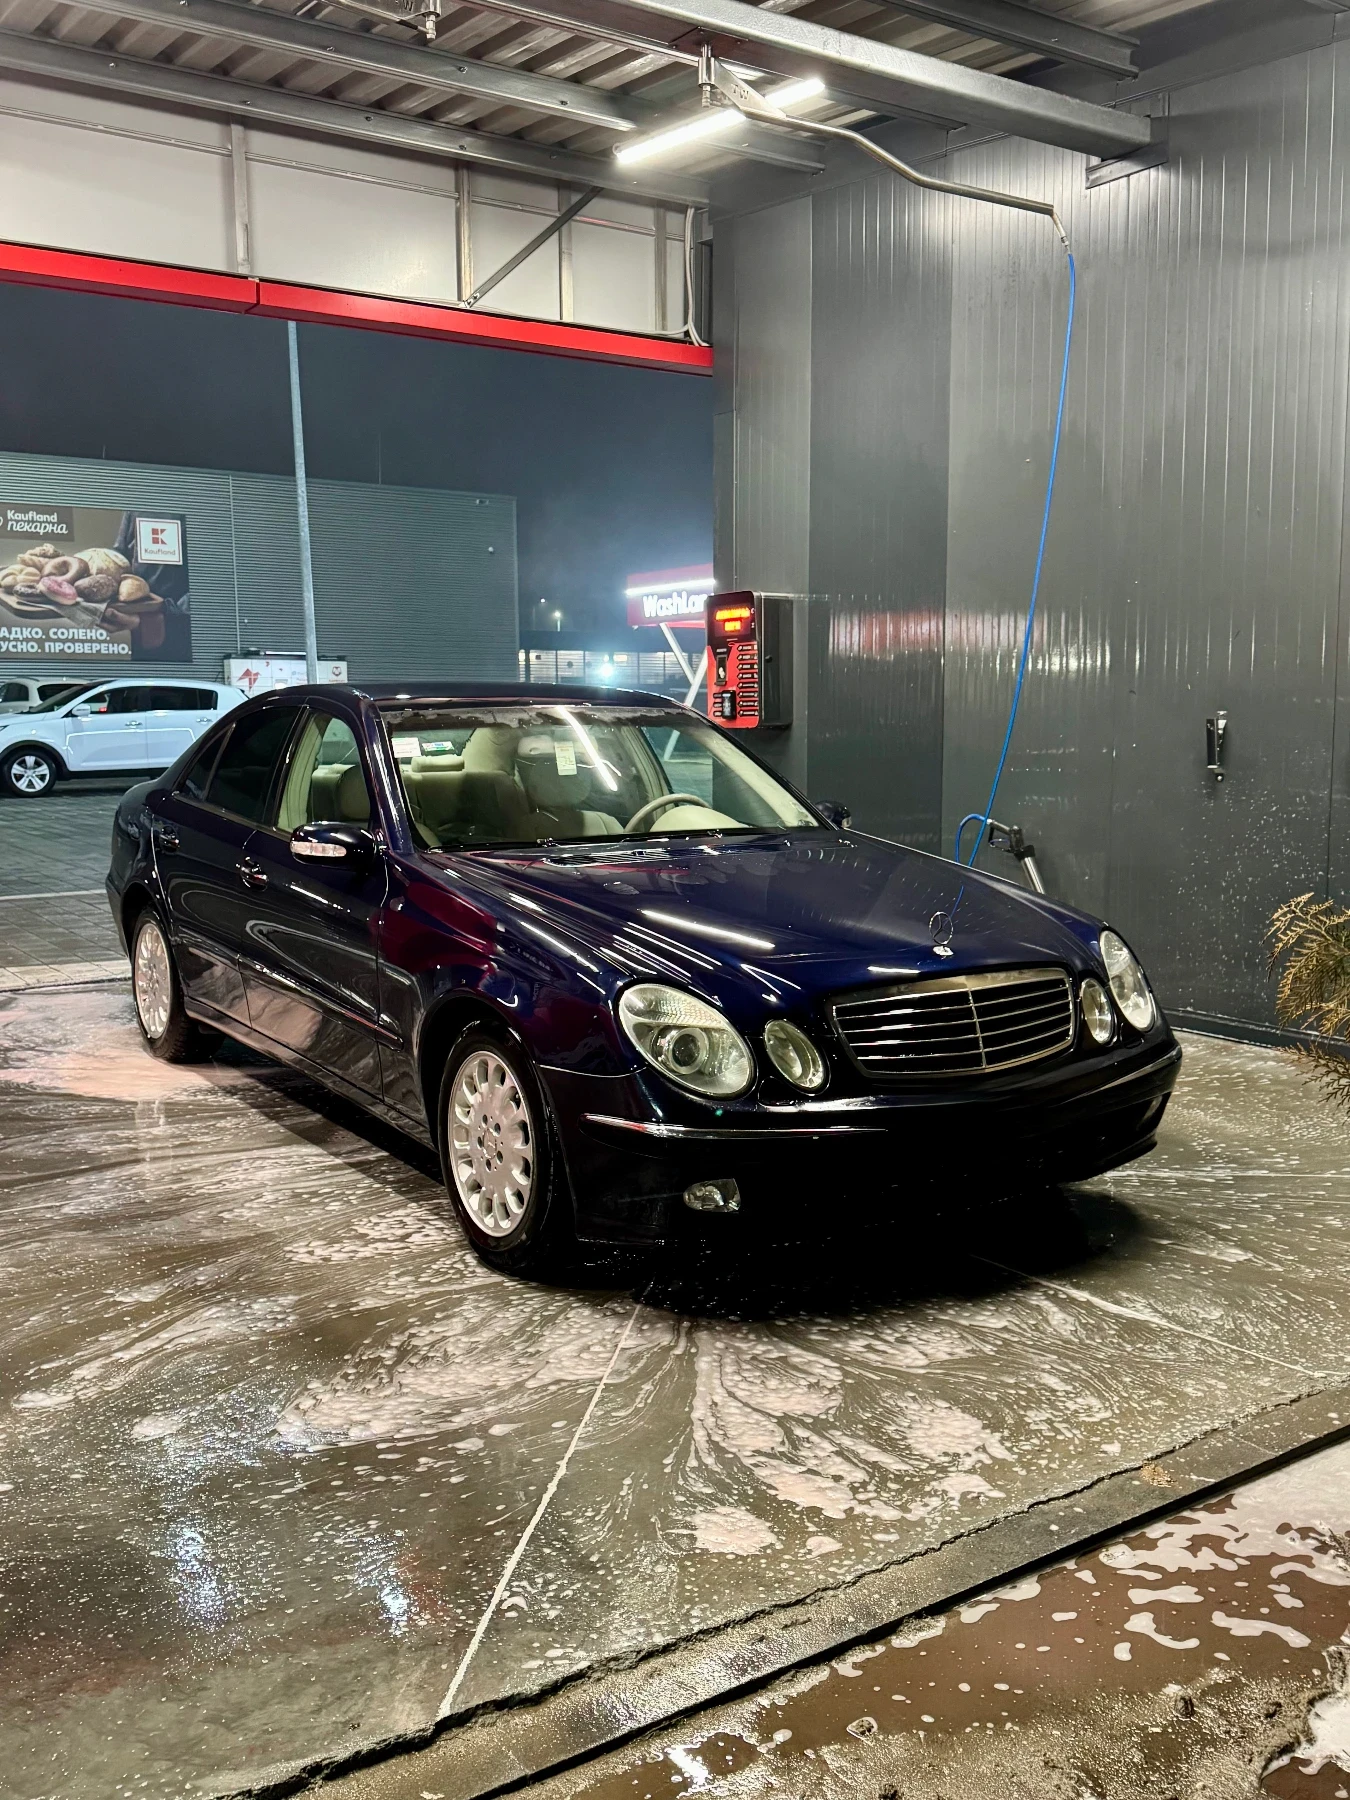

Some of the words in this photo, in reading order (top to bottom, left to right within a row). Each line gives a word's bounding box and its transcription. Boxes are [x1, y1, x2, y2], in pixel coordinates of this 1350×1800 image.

[731, 83, 749, 100] TW
[7, 510, 57, 522] Kaufland
[7, 519, 68, 535] пекарна
[144, 547, 176, 556] Kaufland
[642, 590, 714, 618] WashLan
[49, 628, 110, 640] СОЛЕНО.
[45, 641, 132, 655] ПРОВЕРЕНО.
